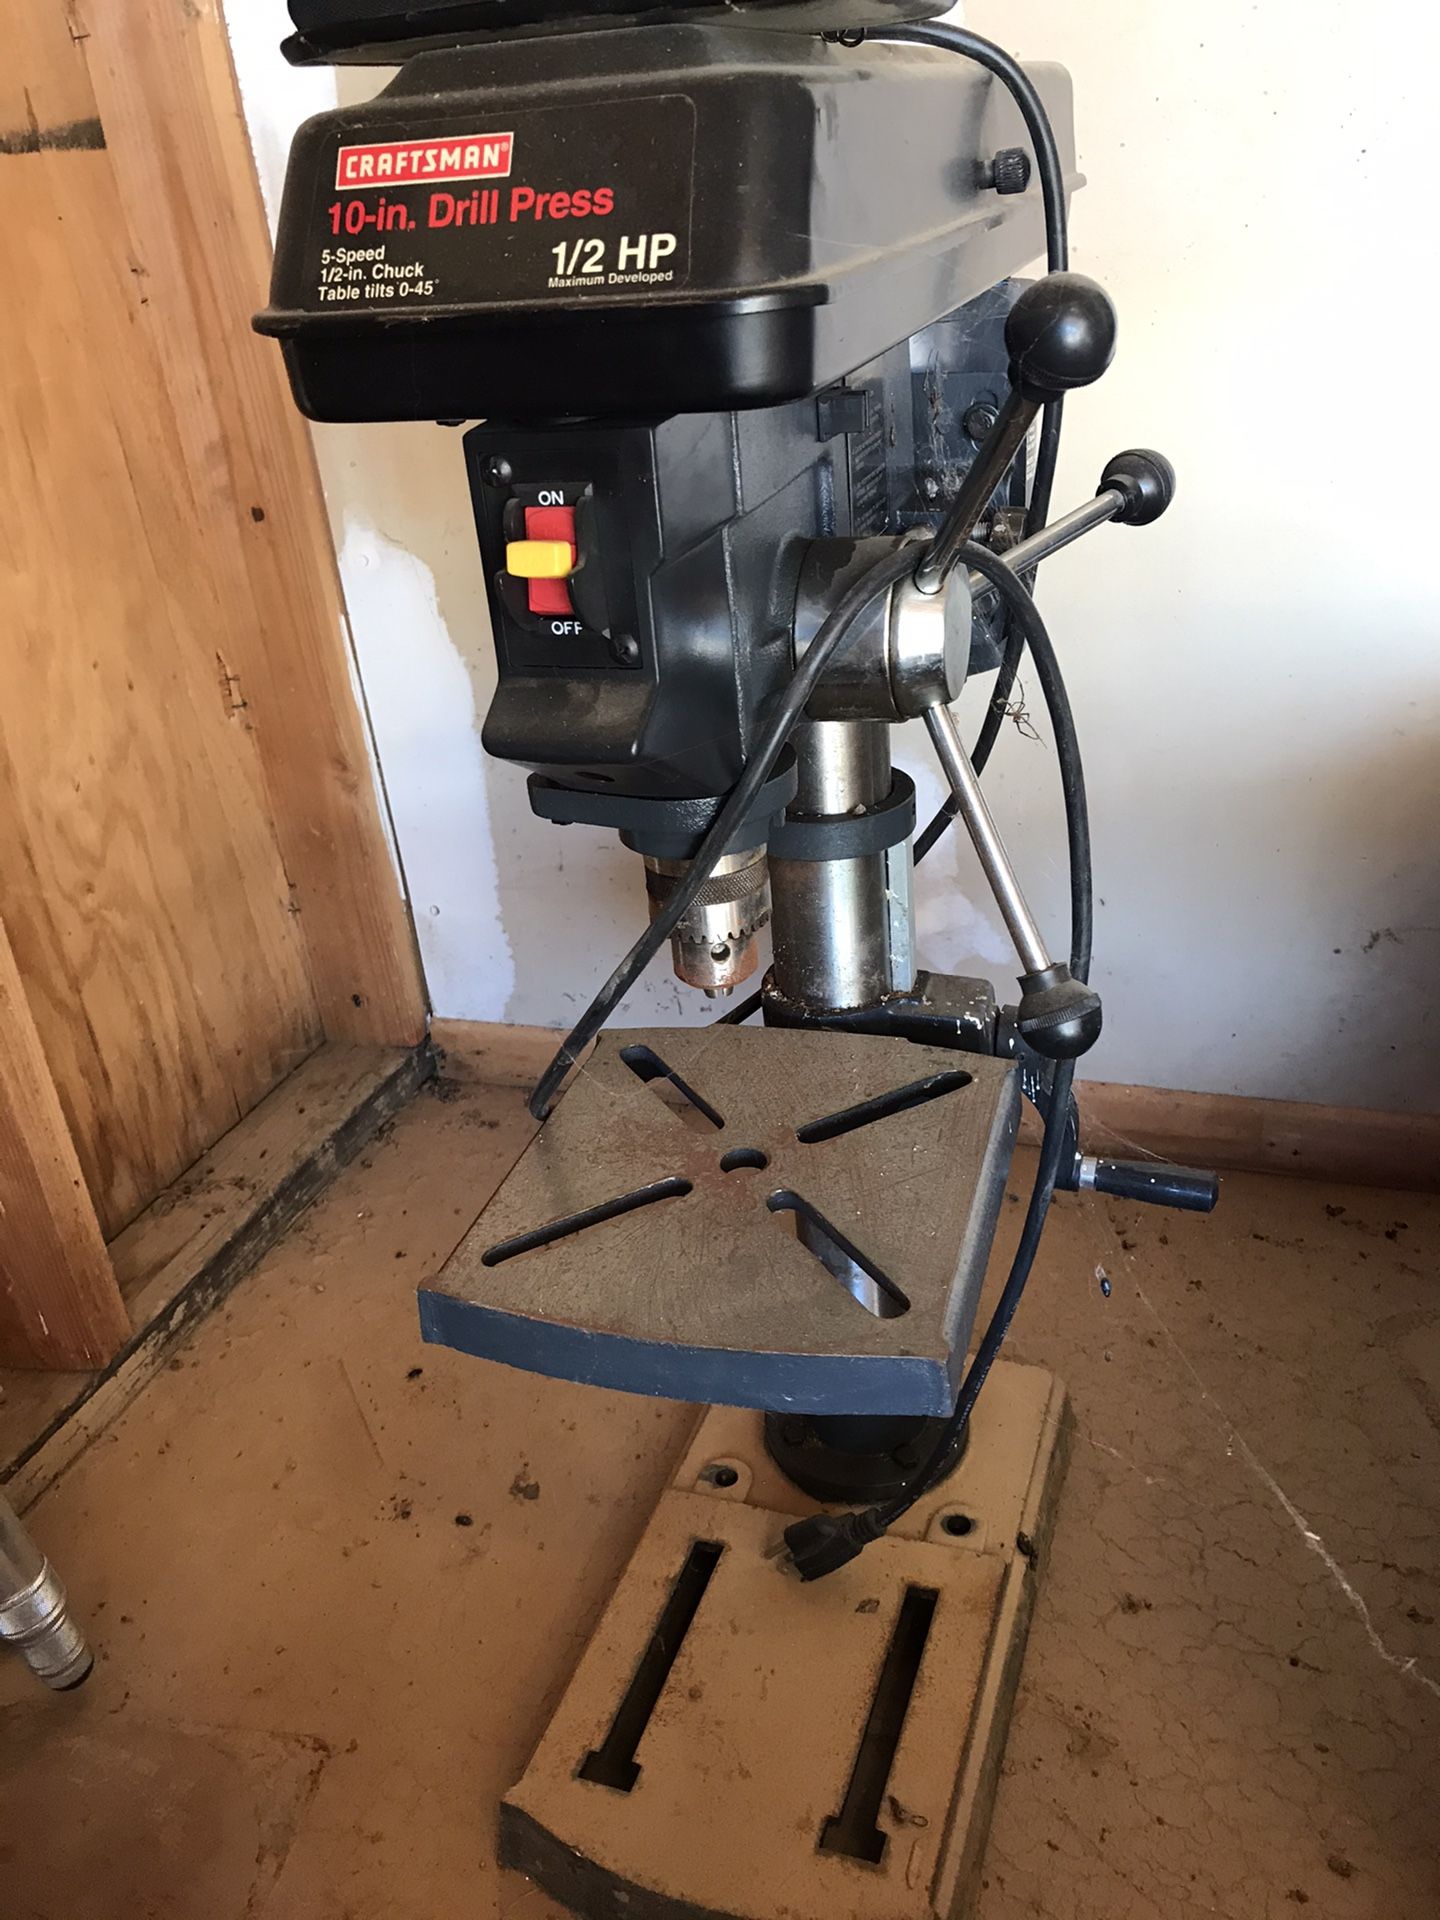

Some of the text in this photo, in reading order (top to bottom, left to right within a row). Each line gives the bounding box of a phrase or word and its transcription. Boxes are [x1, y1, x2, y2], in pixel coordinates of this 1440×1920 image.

[345, 143, 501, 179] CRAFTSMAN
[328, 186, 614, 235] 10-in. Drill Press
[321, 245, 386, 265] 5-Speed
[551, 232, 677, 275] 1/2 HP
[320, 262, 424, 283] 1/2-in. Chuck
[548, 270, 673, 288] Maximum Developed
[318, 285, 360, 301] Table
[364, 283, 394, 299] tilts
[538, 490, 564, 506] ON
[551, 621, 583, 636] OFF
